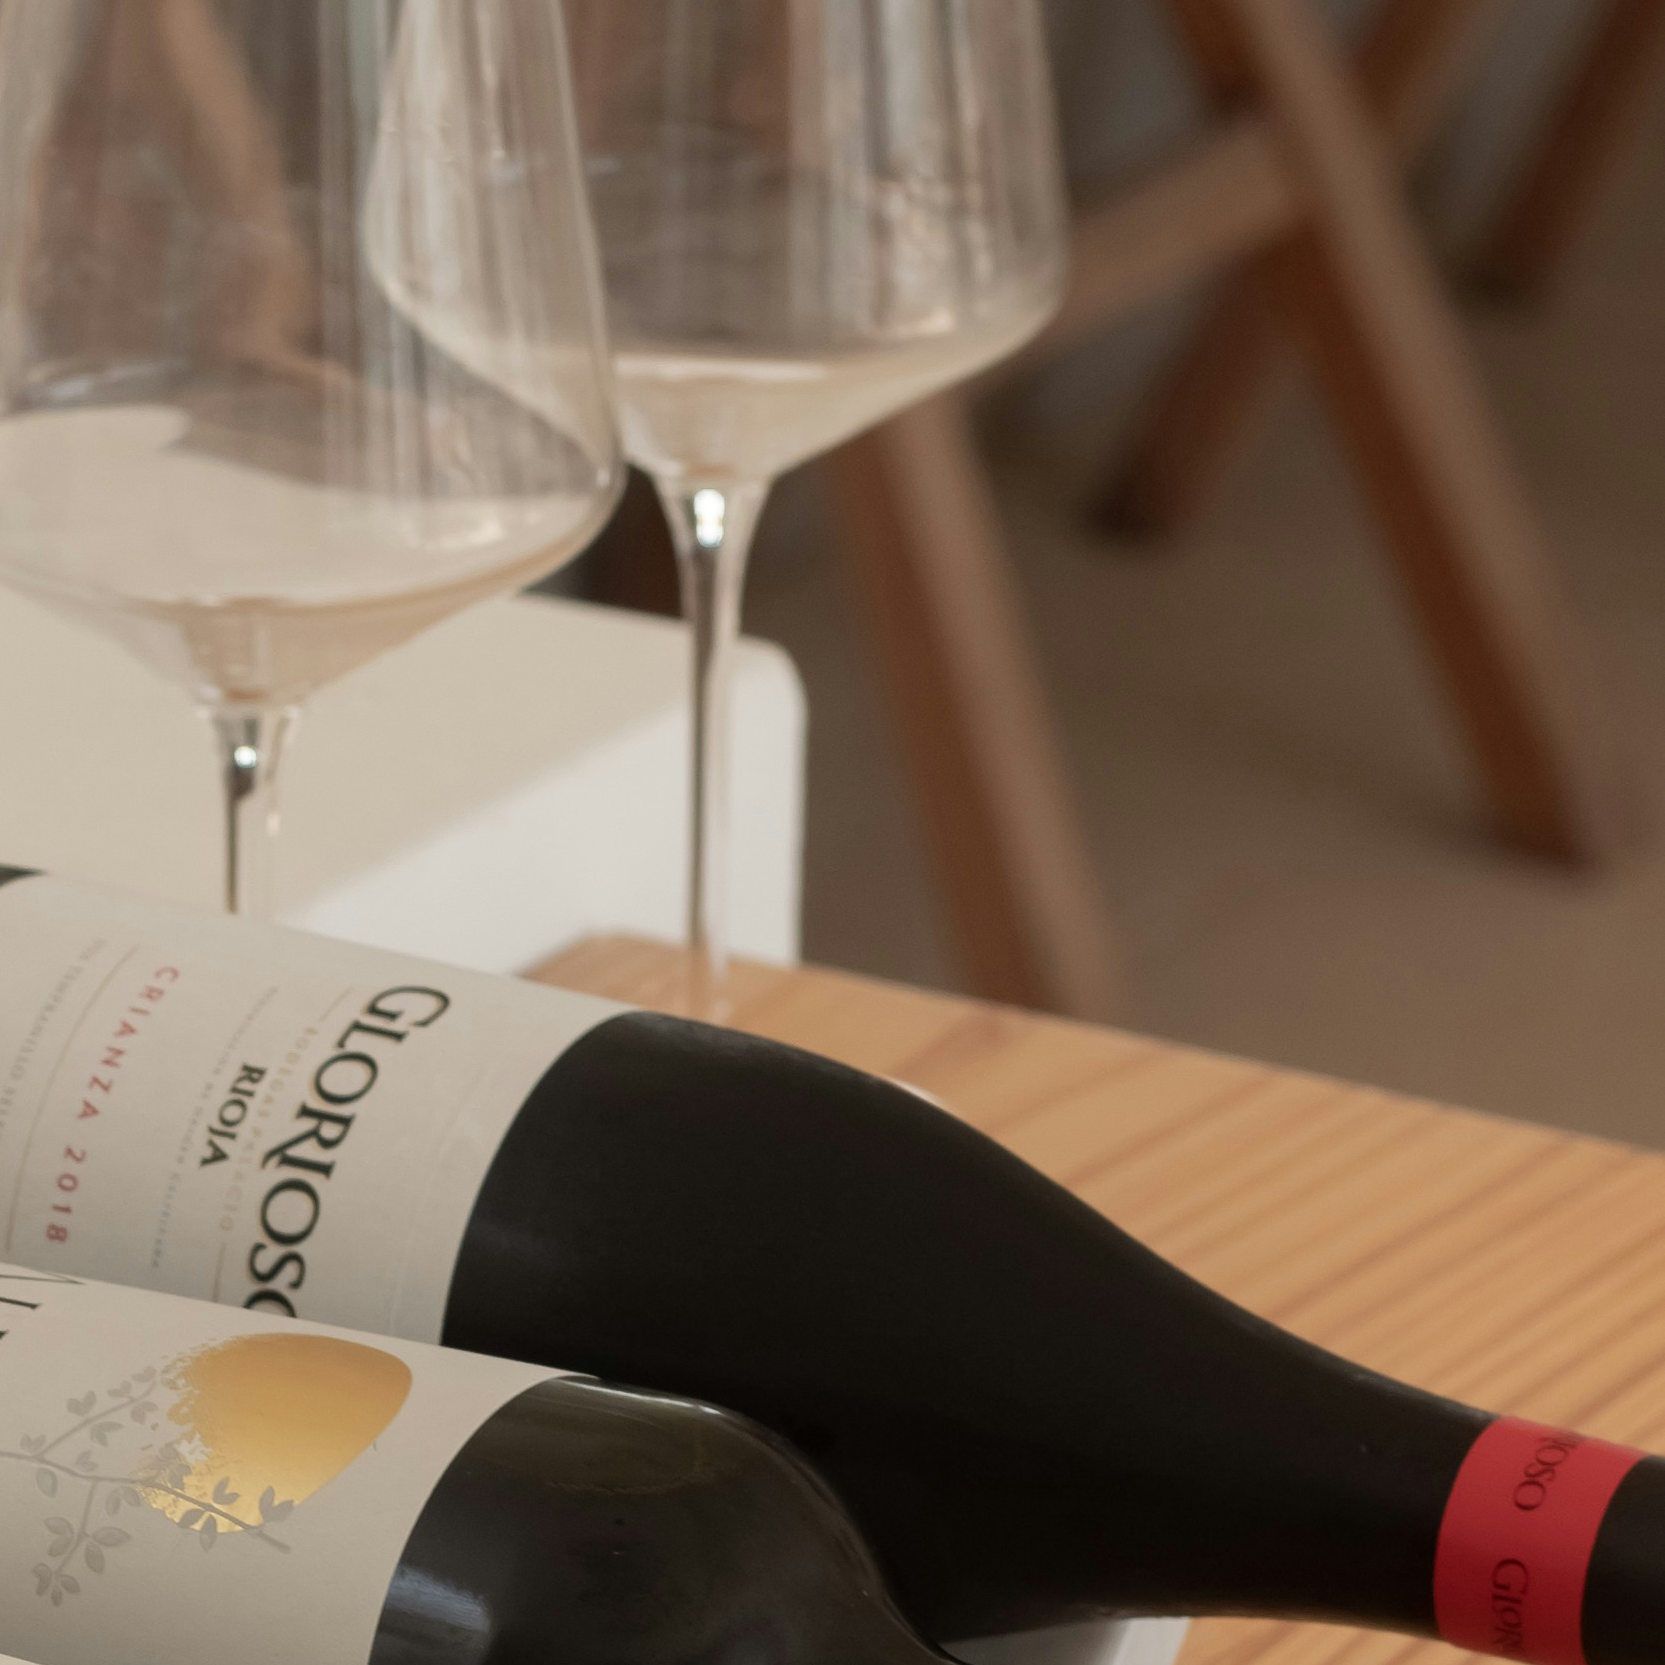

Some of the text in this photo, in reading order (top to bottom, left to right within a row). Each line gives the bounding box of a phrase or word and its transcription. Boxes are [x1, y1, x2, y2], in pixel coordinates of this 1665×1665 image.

[76, 965, 181, 1120] CRIANZA
[198, 1063, 269, 1170] RIOJA
[44, 1143, 88, 1244] 2018
